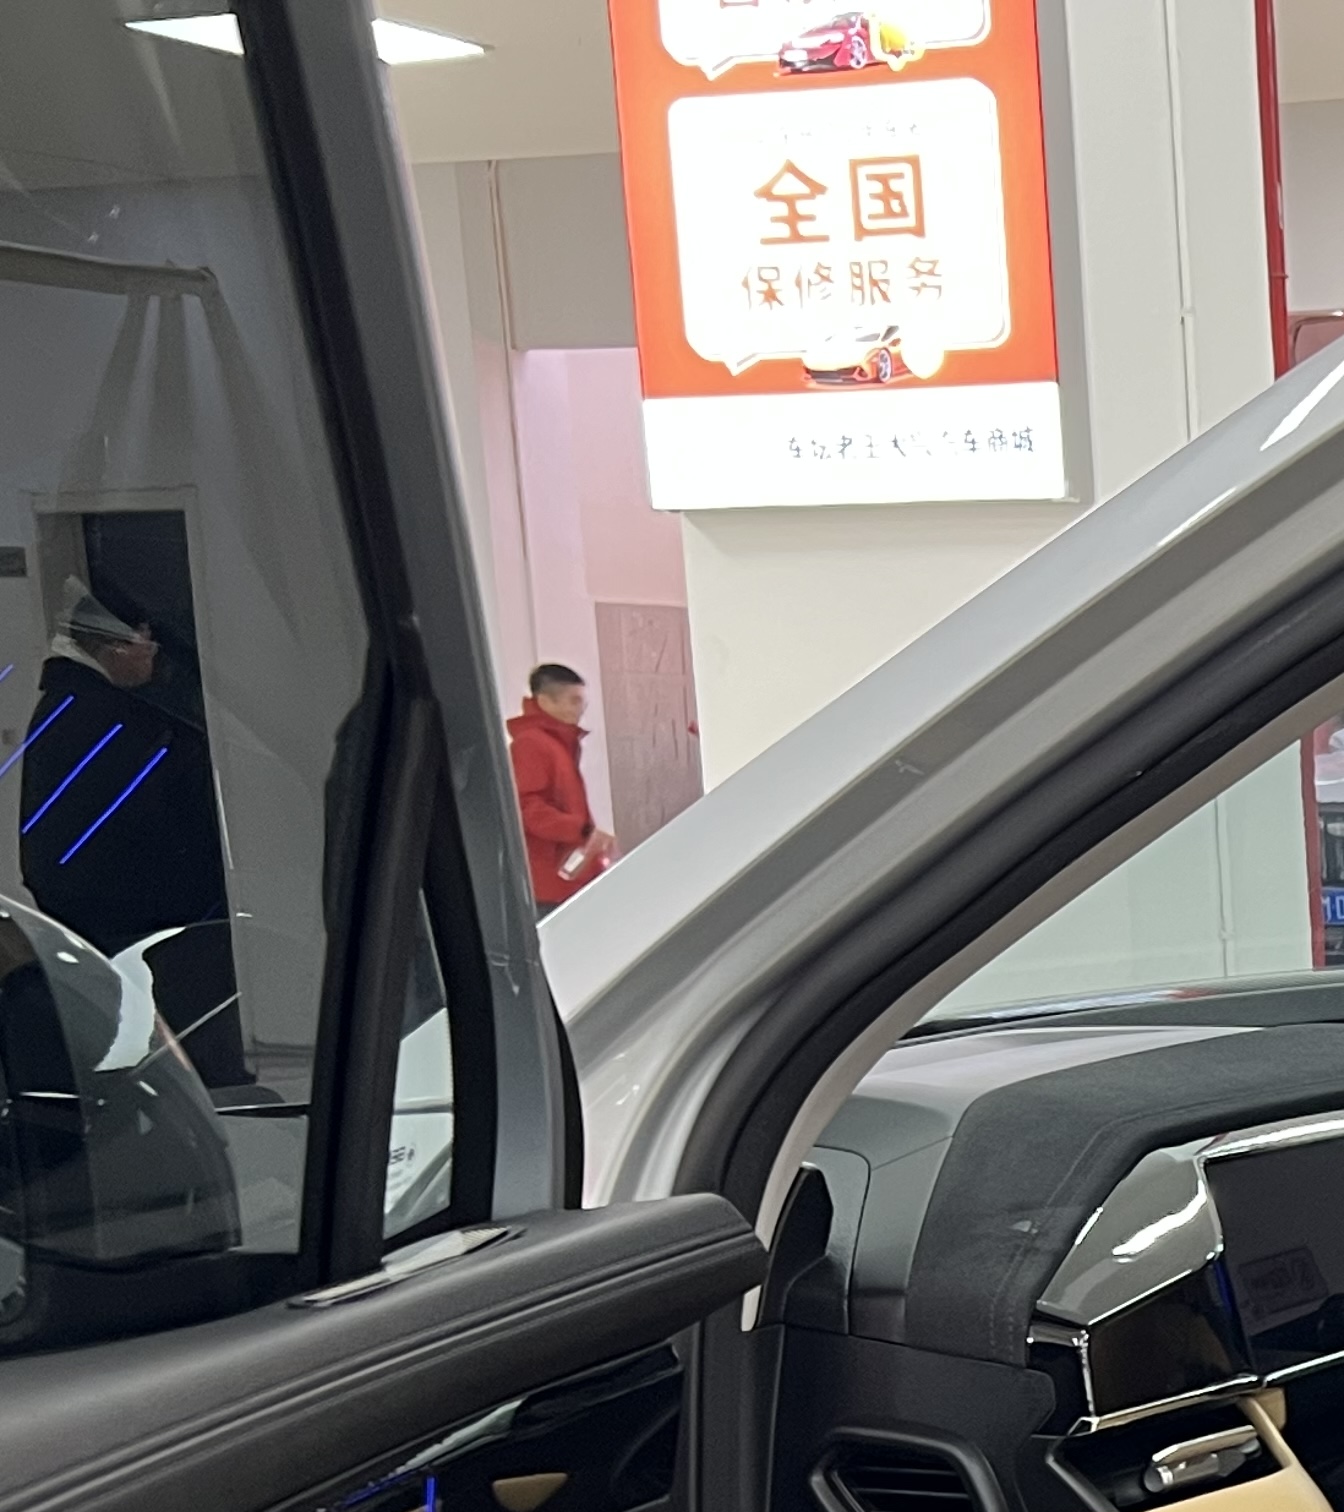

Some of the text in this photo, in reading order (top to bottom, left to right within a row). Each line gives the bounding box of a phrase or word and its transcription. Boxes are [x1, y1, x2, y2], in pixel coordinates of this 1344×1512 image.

[753, 155, 926, 245] 全国
[741, 257, 943, 311] 保修服务
